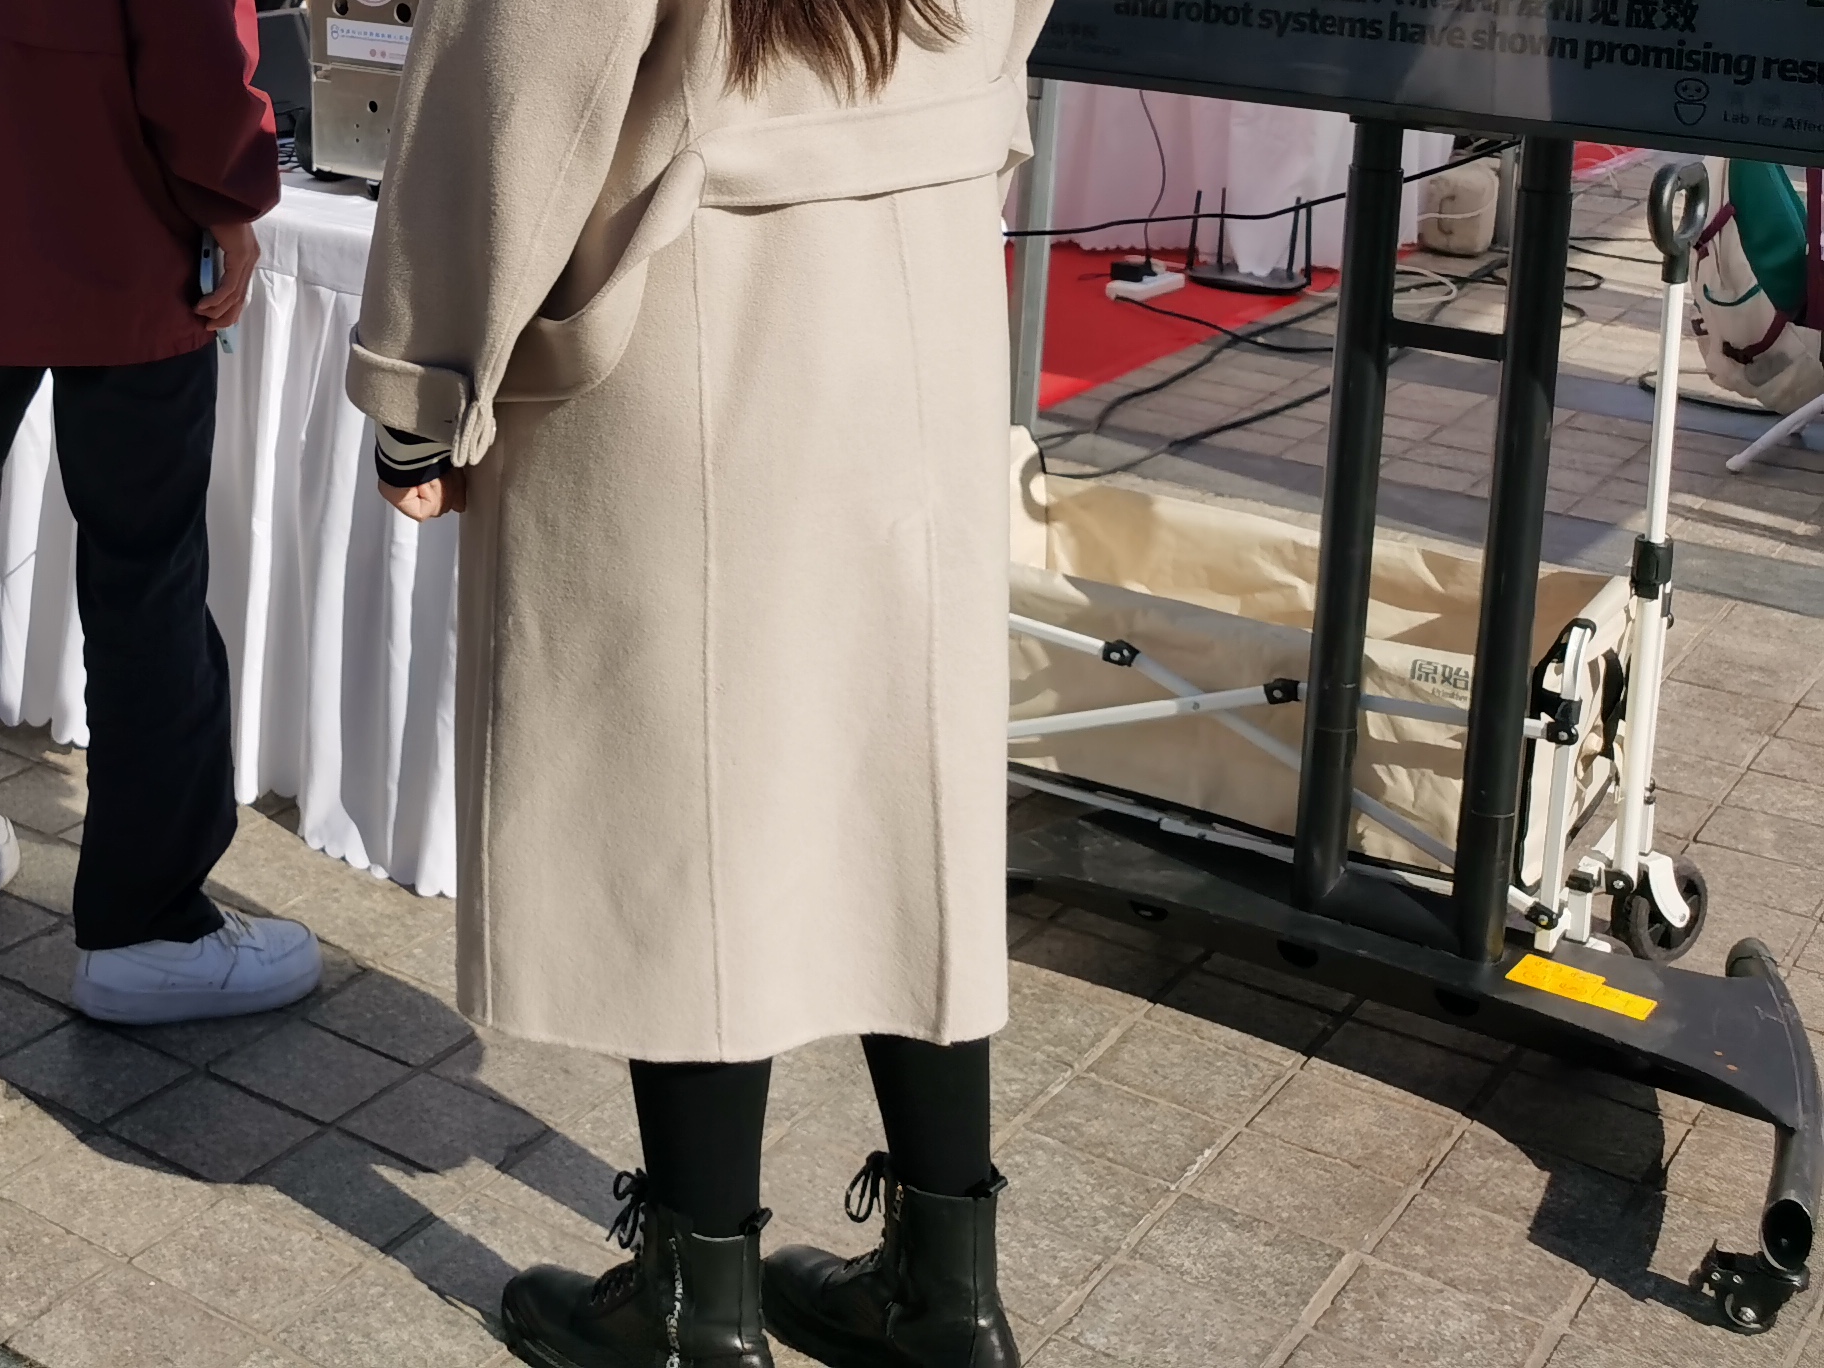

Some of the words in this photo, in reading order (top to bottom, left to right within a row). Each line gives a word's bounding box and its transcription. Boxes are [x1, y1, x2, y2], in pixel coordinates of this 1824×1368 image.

[1258, 7, 1383, 41] systems
[1388, 10, 1466, 49] have
[1472, 20, 1578, 60] shown
[1584, 38, 1757, 86] promising
[1723, 110, 1750, 125] Lab
[1757, 113, 1778, 127] for
[1410, 658, 1470, 691] 原始
